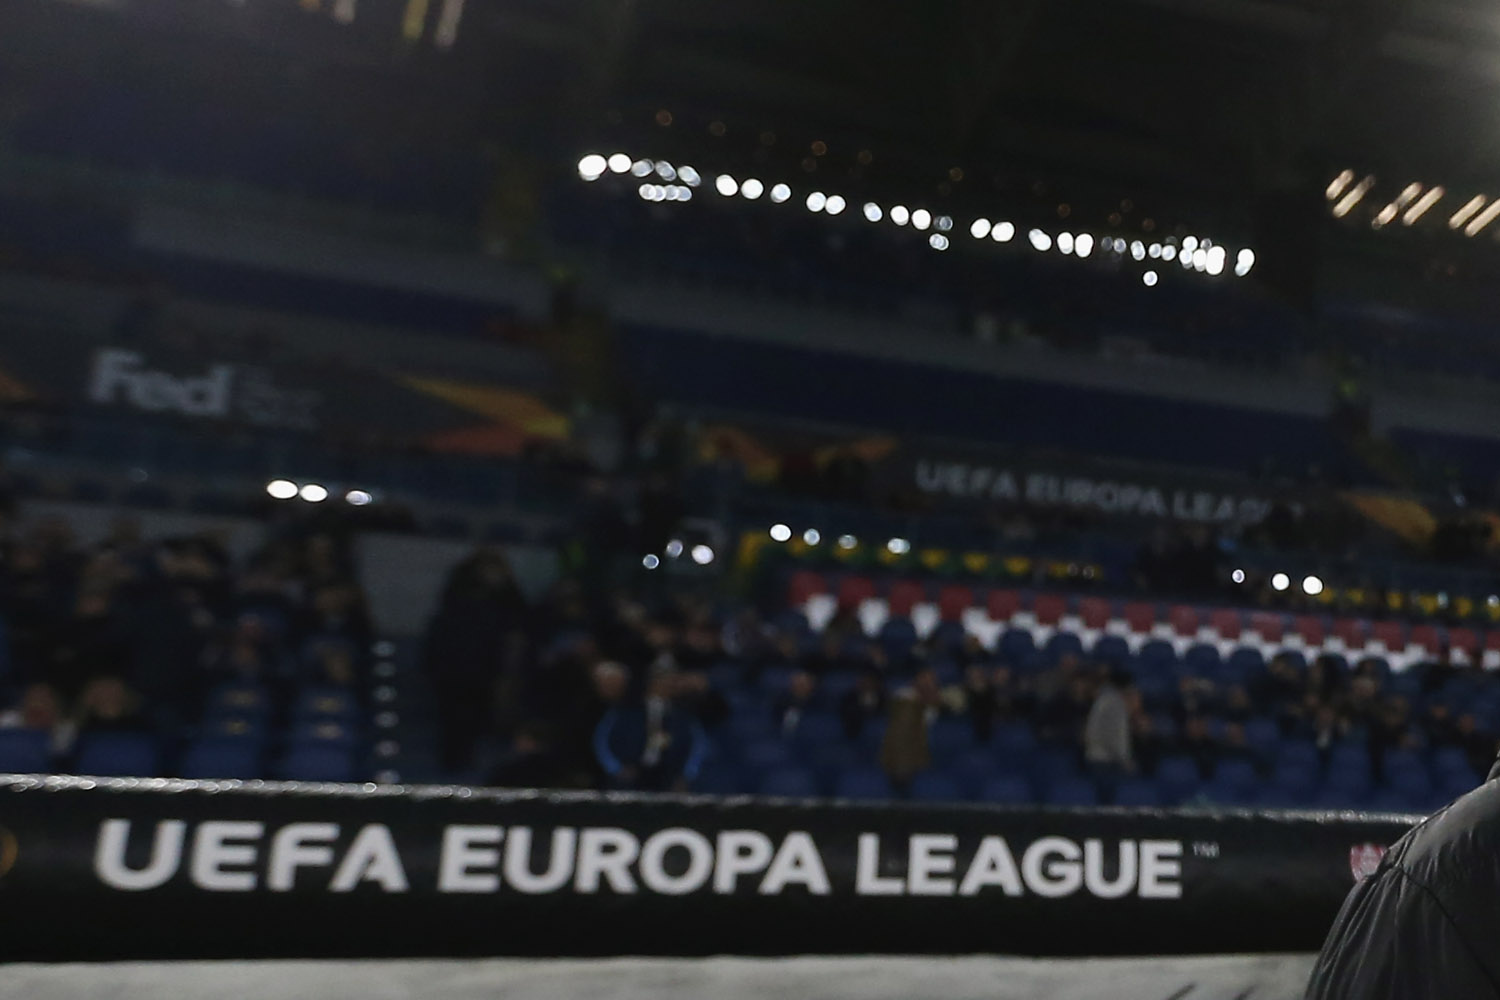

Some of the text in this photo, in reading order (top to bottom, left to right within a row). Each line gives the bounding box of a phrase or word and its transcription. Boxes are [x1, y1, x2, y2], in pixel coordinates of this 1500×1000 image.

[915, 458, 1019, 501] UEFA
[1025, 471, 1168, 517] EUROPA
[94, 819, 408, 892] UEFA
[437, 825, 831, 895] EUROPA
[856, 833, 1183, 899] LEAGUE
